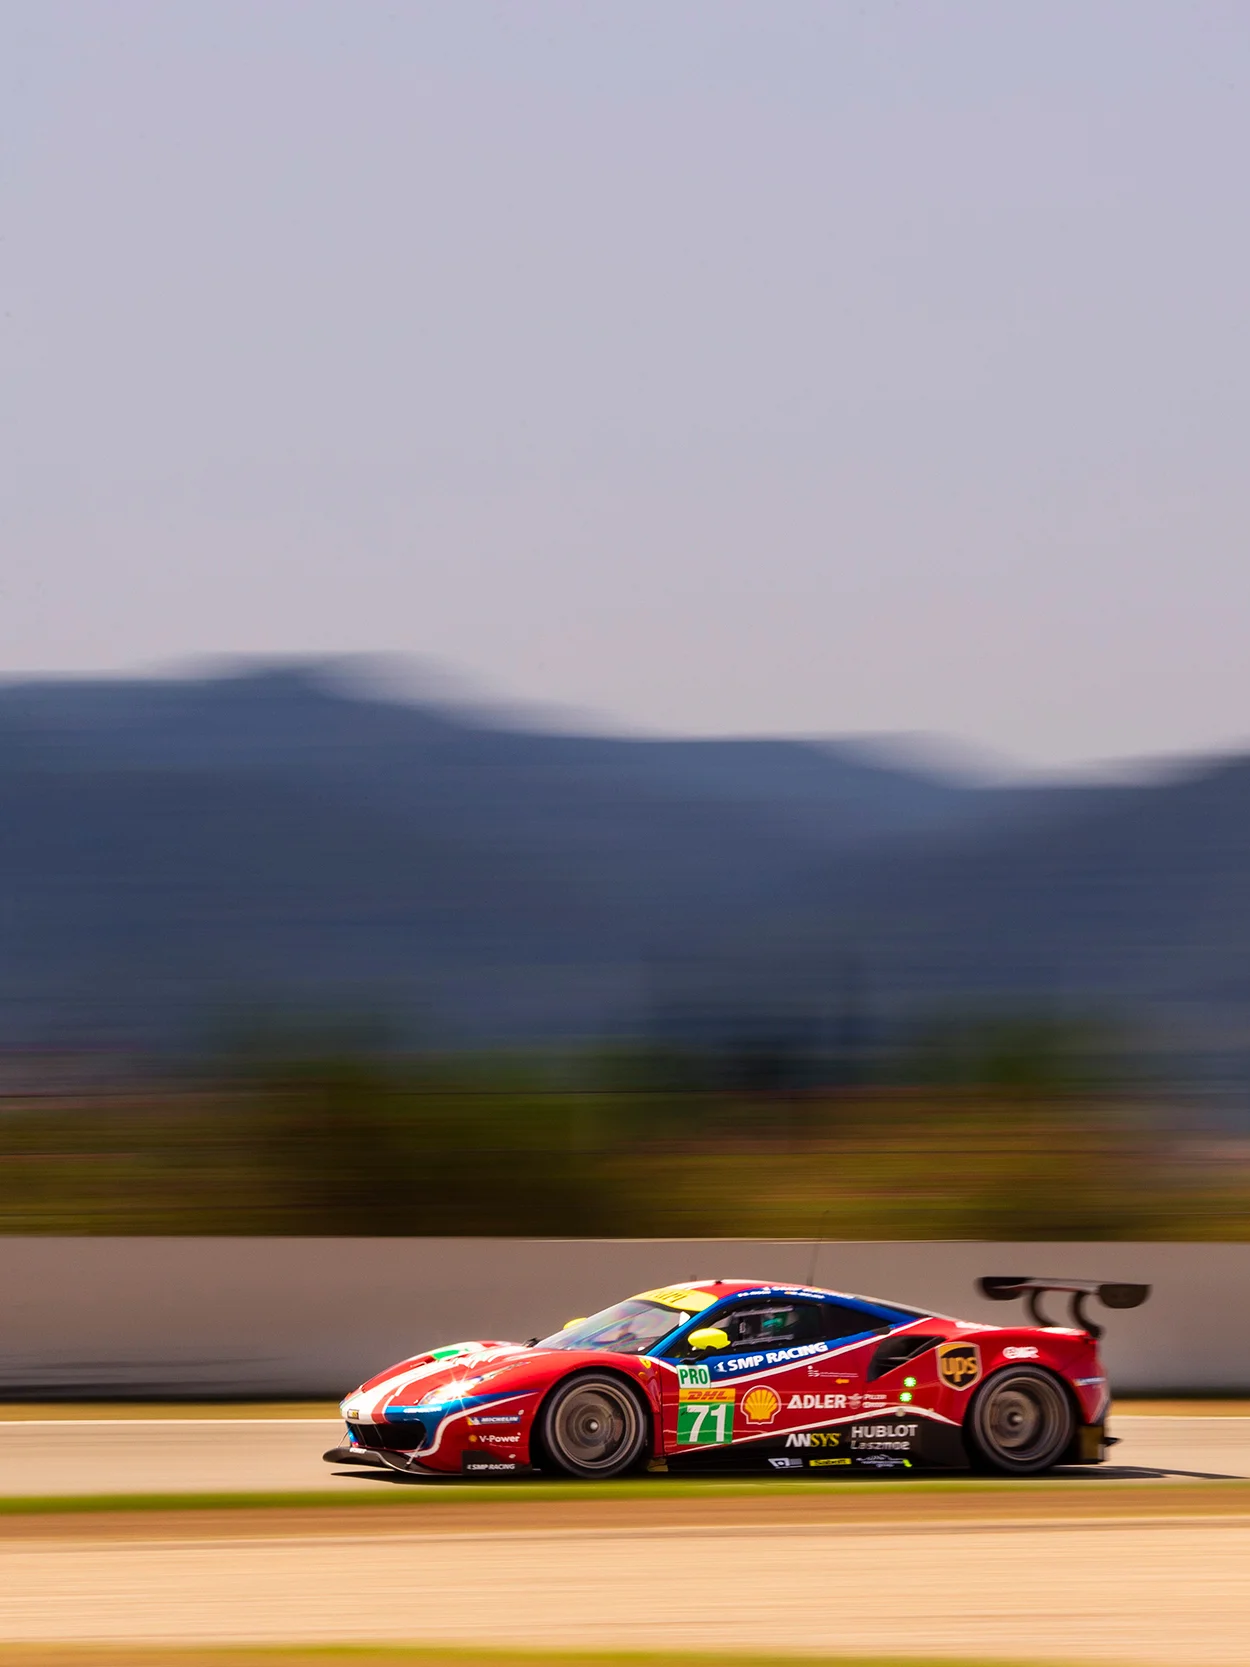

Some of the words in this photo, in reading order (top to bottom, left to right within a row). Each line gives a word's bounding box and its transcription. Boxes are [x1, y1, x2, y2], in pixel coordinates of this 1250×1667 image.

[727, 1355, 764, 1372] SMP
[765, 1342, 829, 1364] RACING
[679, 1368, 709, 1385] PRO
[942, 1356, 977, 1383] ups
[687, 1391, 728, 1400] DHL
[786, 1394, 847, 1410] ADLER
[687, 1404, 727, 1442] 71
[851, 1424, 918, 1438] HUBLOT
[785, 1433, 841, 1447] ANSYS
